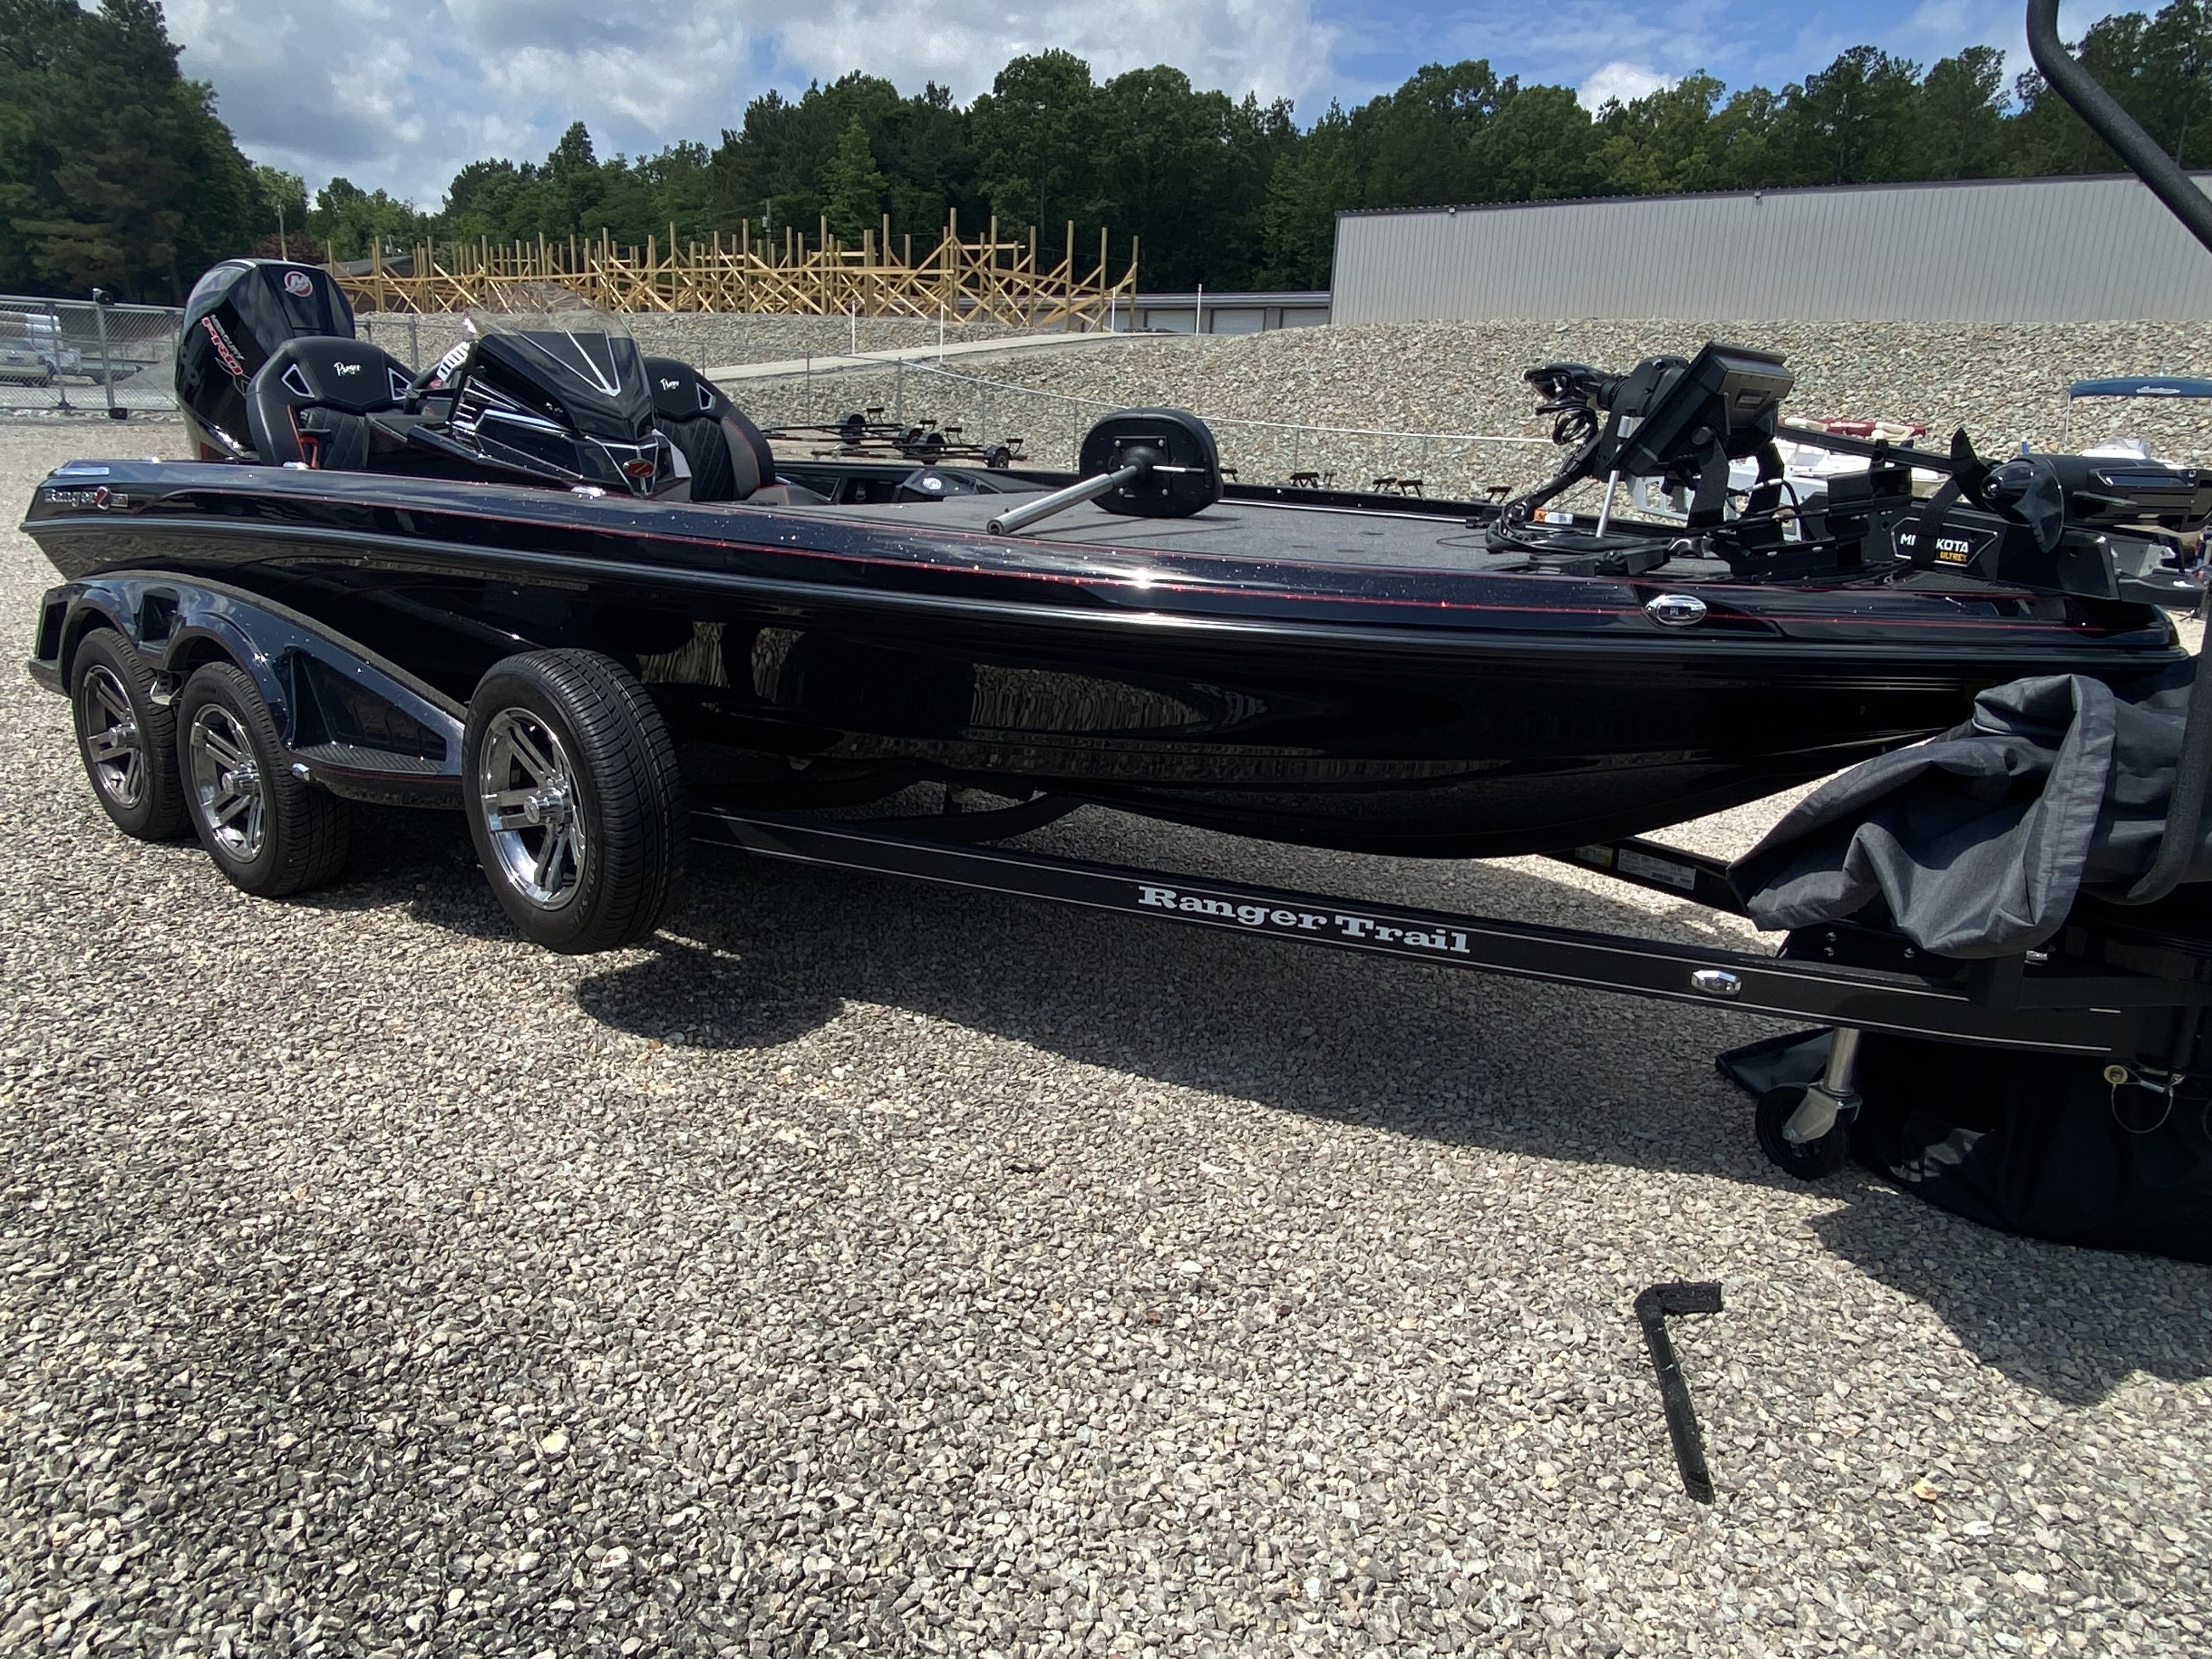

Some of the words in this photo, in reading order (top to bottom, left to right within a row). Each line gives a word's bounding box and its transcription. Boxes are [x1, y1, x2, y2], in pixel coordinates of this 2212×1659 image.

[210, 314, 245, 360] MERCURY
[44, 488, 98, 507] Ranger
[1936, 538, 1968, 553] KOTA
[1138, 886, 1327, 930] Ranger
[1335, 915, 1470, 953] Trail
